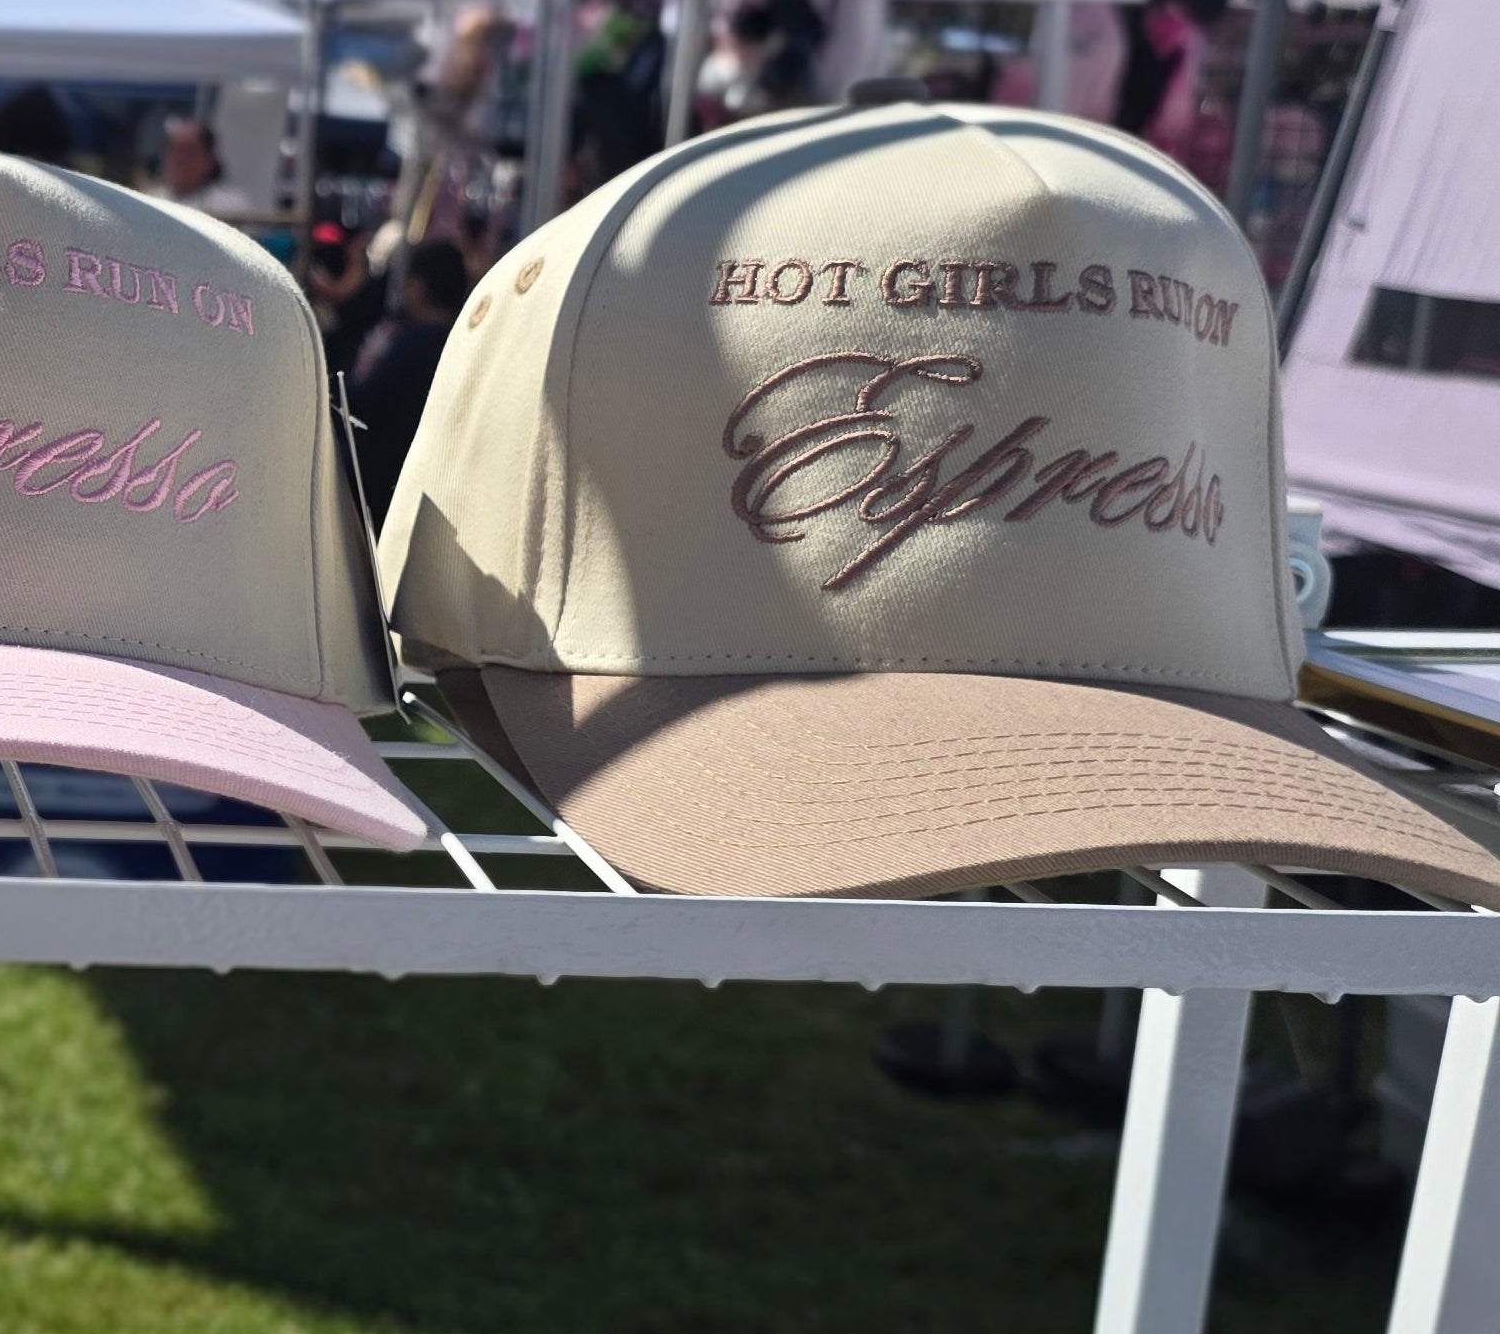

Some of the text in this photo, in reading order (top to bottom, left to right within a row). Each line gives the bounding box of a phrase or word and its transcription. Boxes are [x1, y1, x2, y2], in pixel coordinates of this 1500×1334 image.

[64, 247, 179, 314] RUN
[192, 282, 255, 336] ON
[708, 258, 864, 306] HOT
[880, 258, 1116, 315] GIRLS
[1197, 296, 1238, 347] ON
[723, 351, 1226, 591] Espresso
